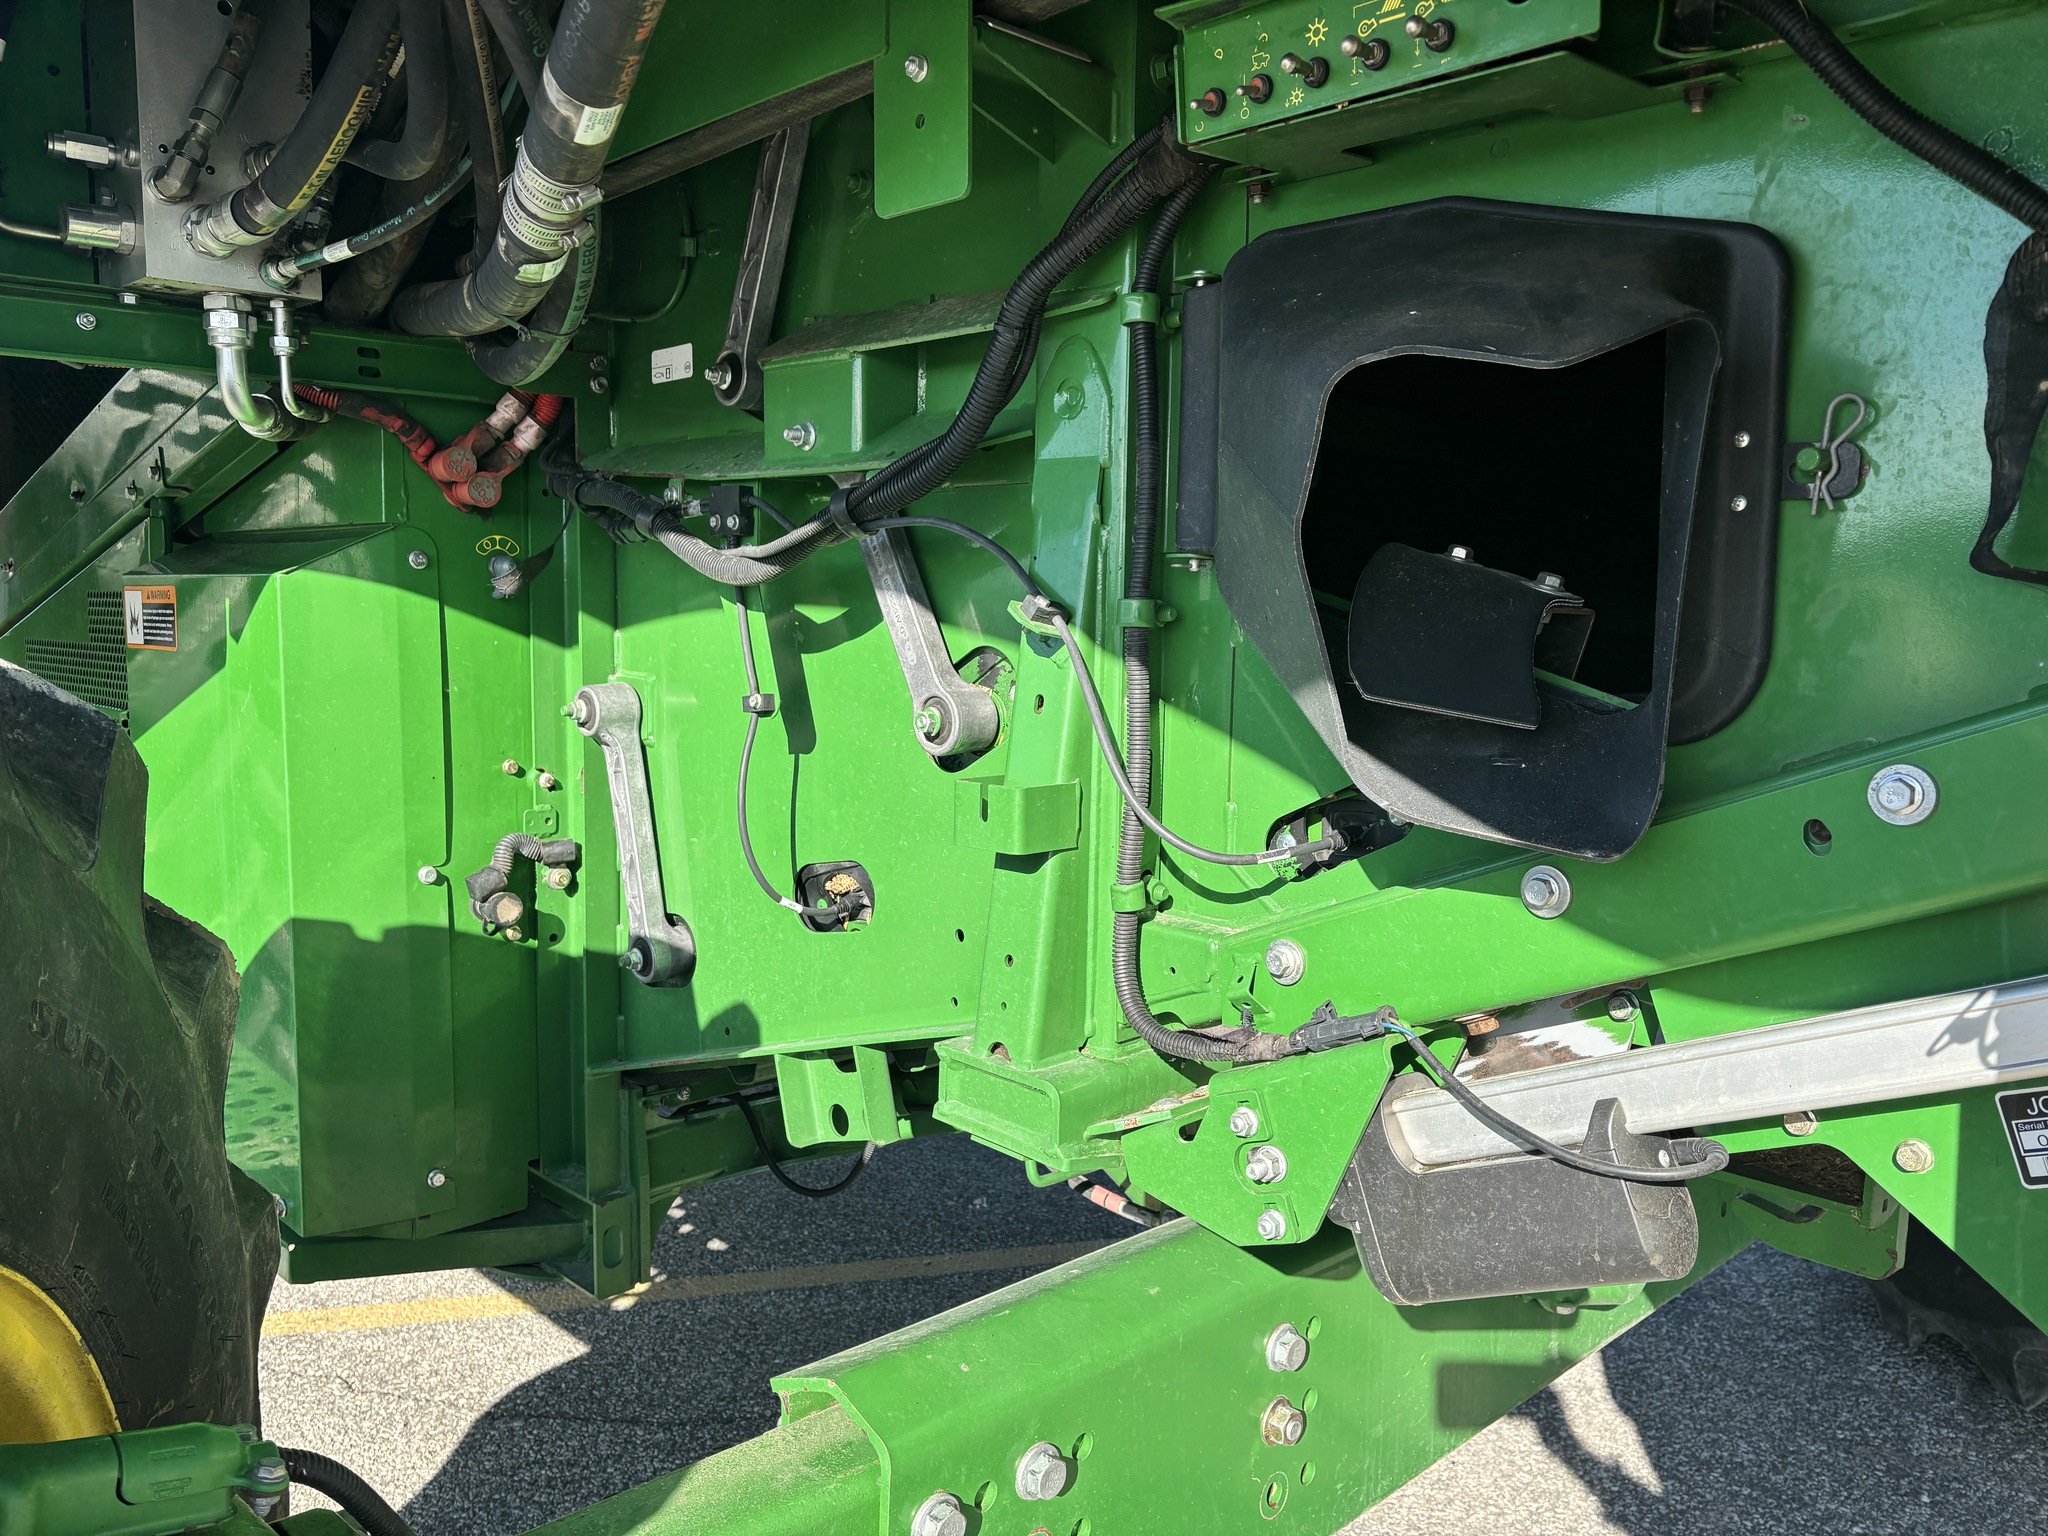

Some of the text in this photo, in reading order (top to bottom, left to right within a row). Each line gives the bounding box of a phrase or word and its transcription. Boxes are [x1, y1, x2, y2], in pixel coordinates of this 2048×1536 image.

[518, 6, 549, 58] Global
[151, 589, 171, 600] WARNING
[28, 998, 143, 1129] SUPER
[2017, 1121, 2045, 1131] Serial
